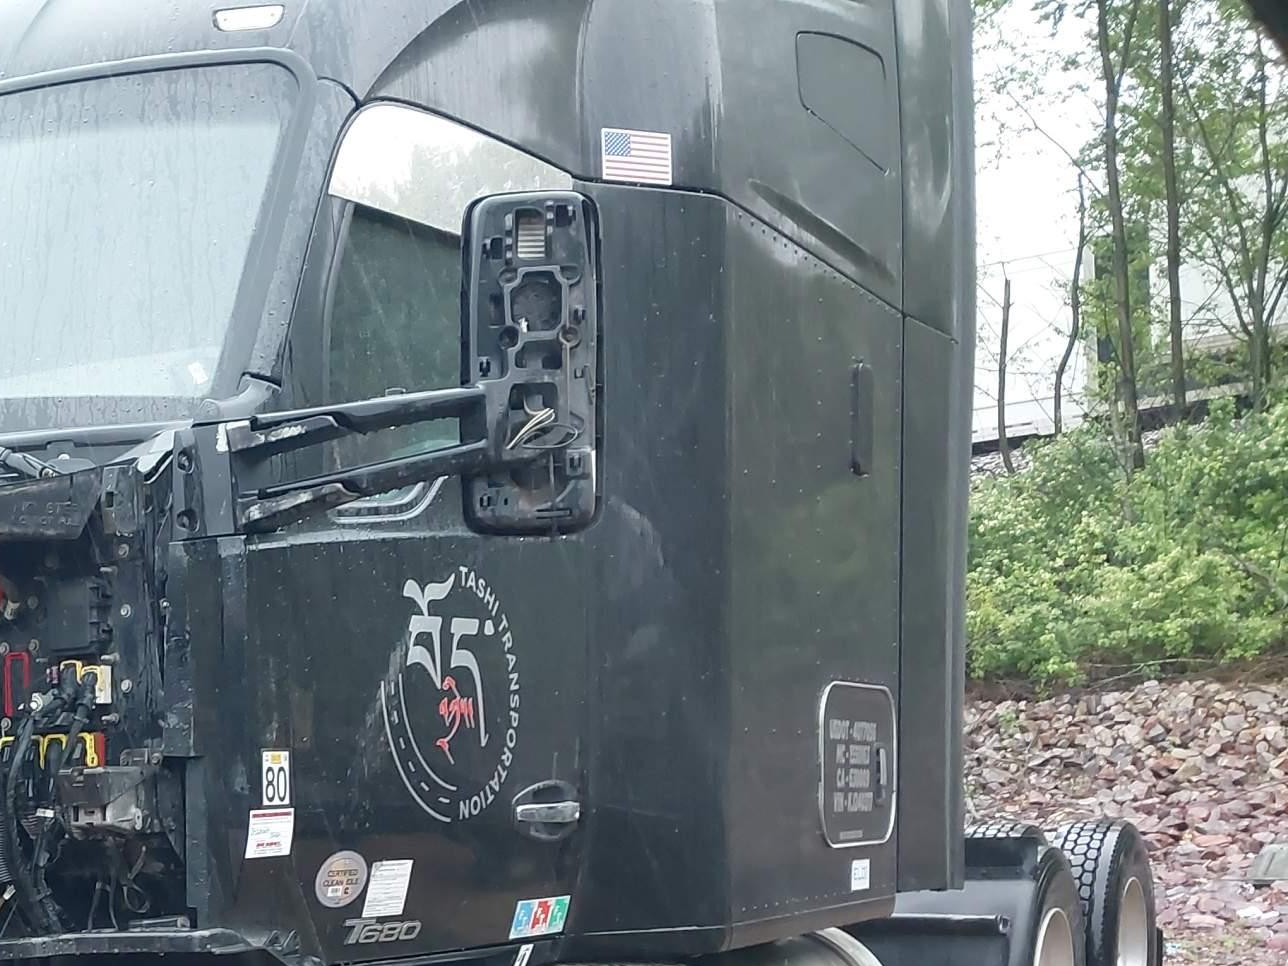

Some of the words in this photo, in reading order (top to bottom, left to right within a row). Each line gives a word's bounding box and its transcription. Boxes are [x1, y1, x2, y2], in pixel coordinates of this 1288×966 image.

[459, 566, 499, 616] TASHI
[459, 614, 519, 820] TRANSPORTATION
[265, 766, 287, 802] 80
[323, 879, 344, 888] CLEAN
[344, 918, 422, 945] T680
